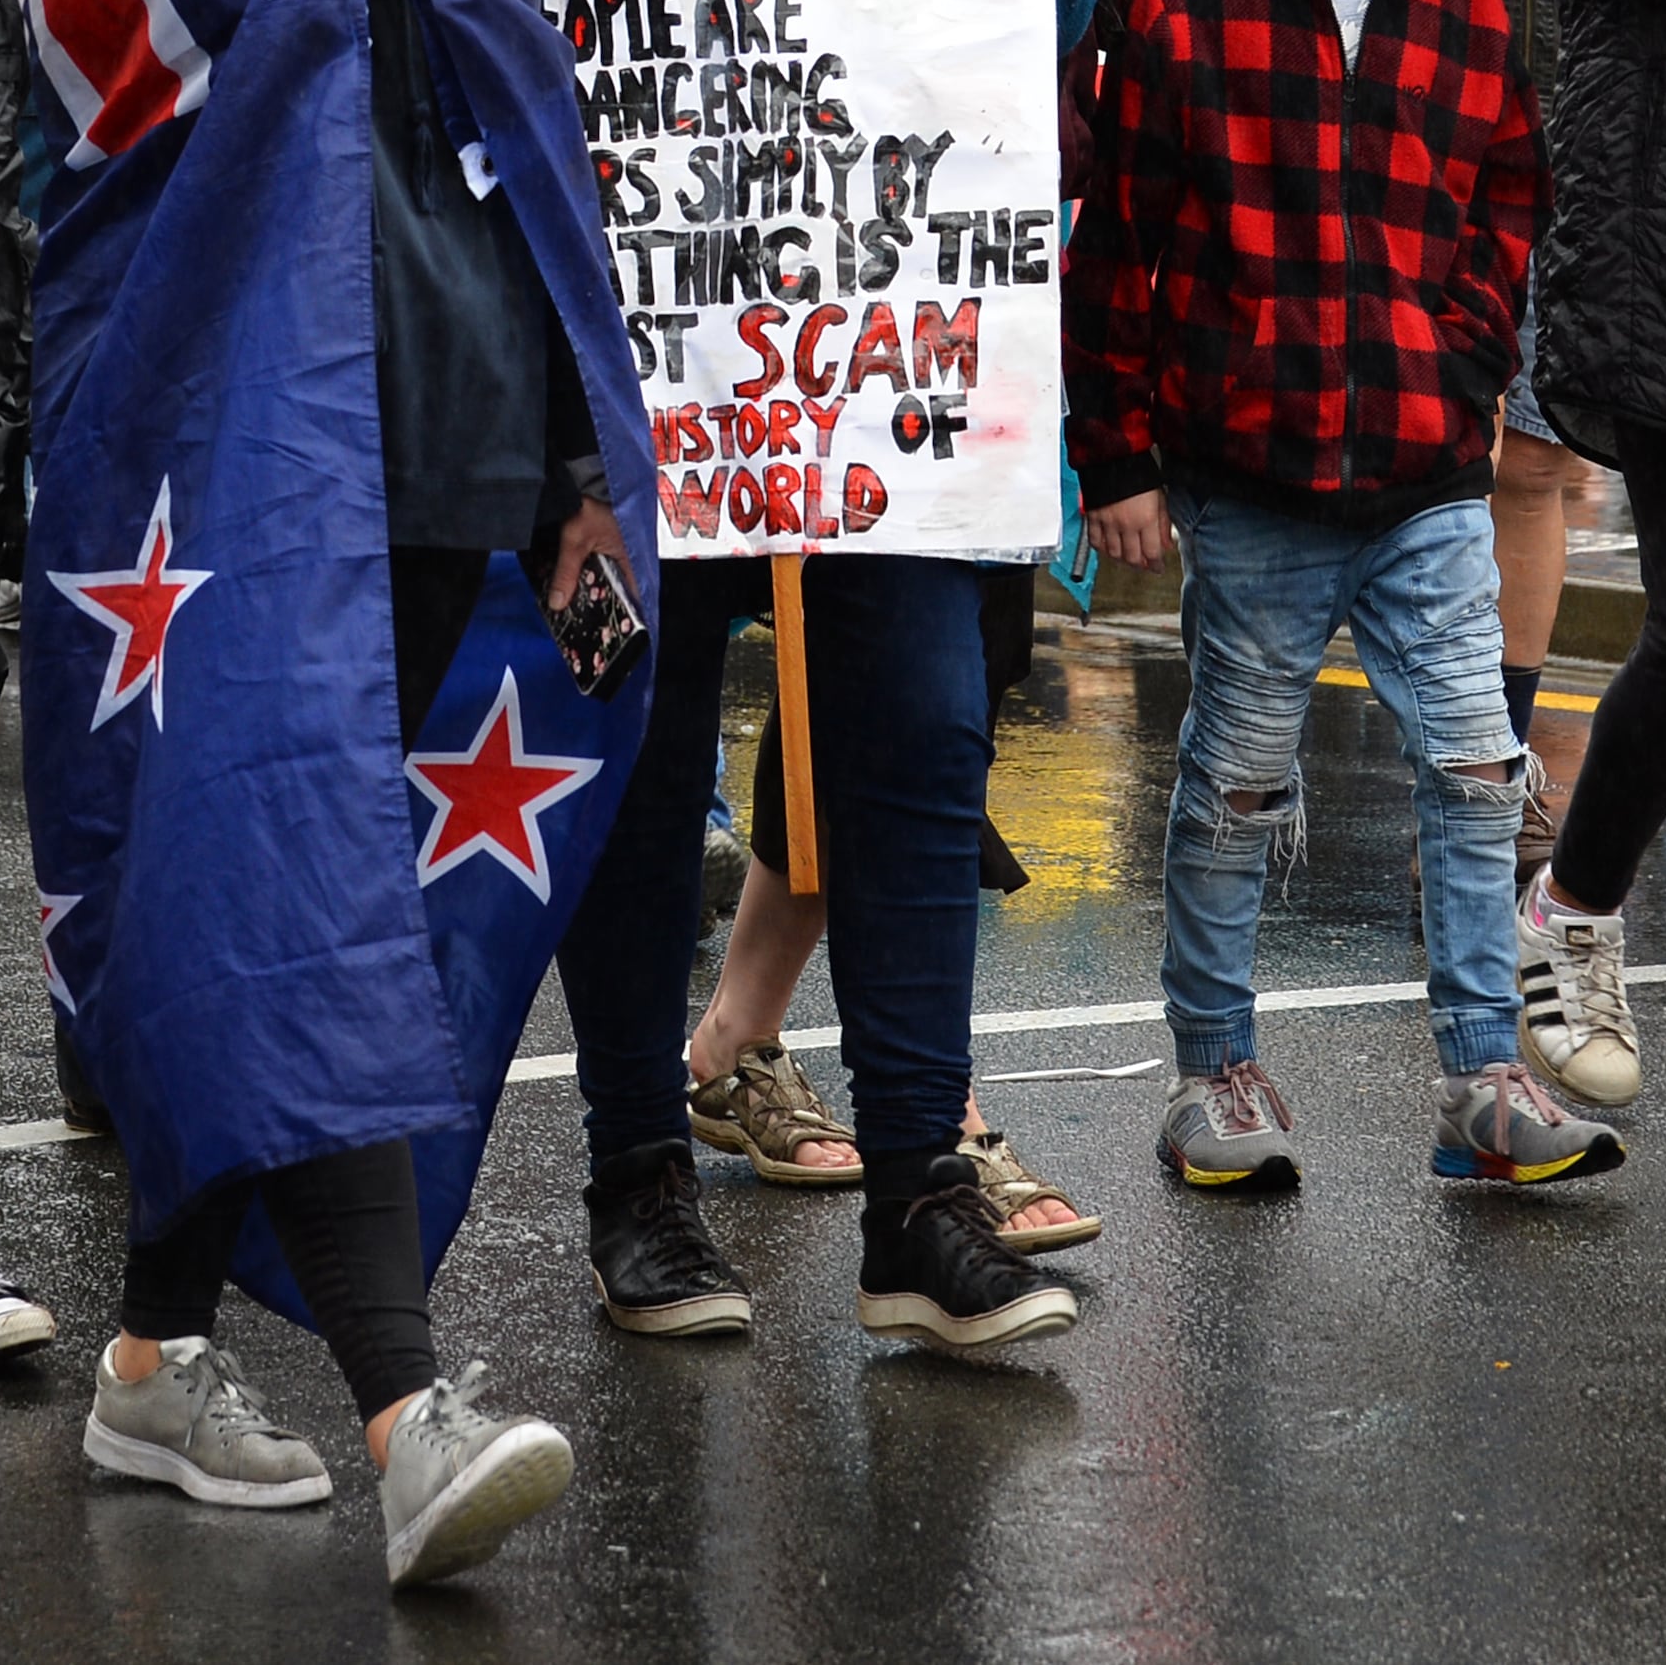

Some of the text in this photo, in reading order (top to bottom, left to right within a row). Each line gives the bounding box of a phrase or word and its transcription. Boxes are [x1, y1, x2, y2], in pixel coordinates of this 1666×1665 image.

[674, 130, 869, 226] SIMPLY
[874, 129, 957, 224] BY
[835, 217, 915, 299] IS
[926, 207, 1056, 289] THE
[732, 297, 983, 400] SCAM
[891, 393, 969, 461] OF
[657, 461, 890, 540] WORLD
